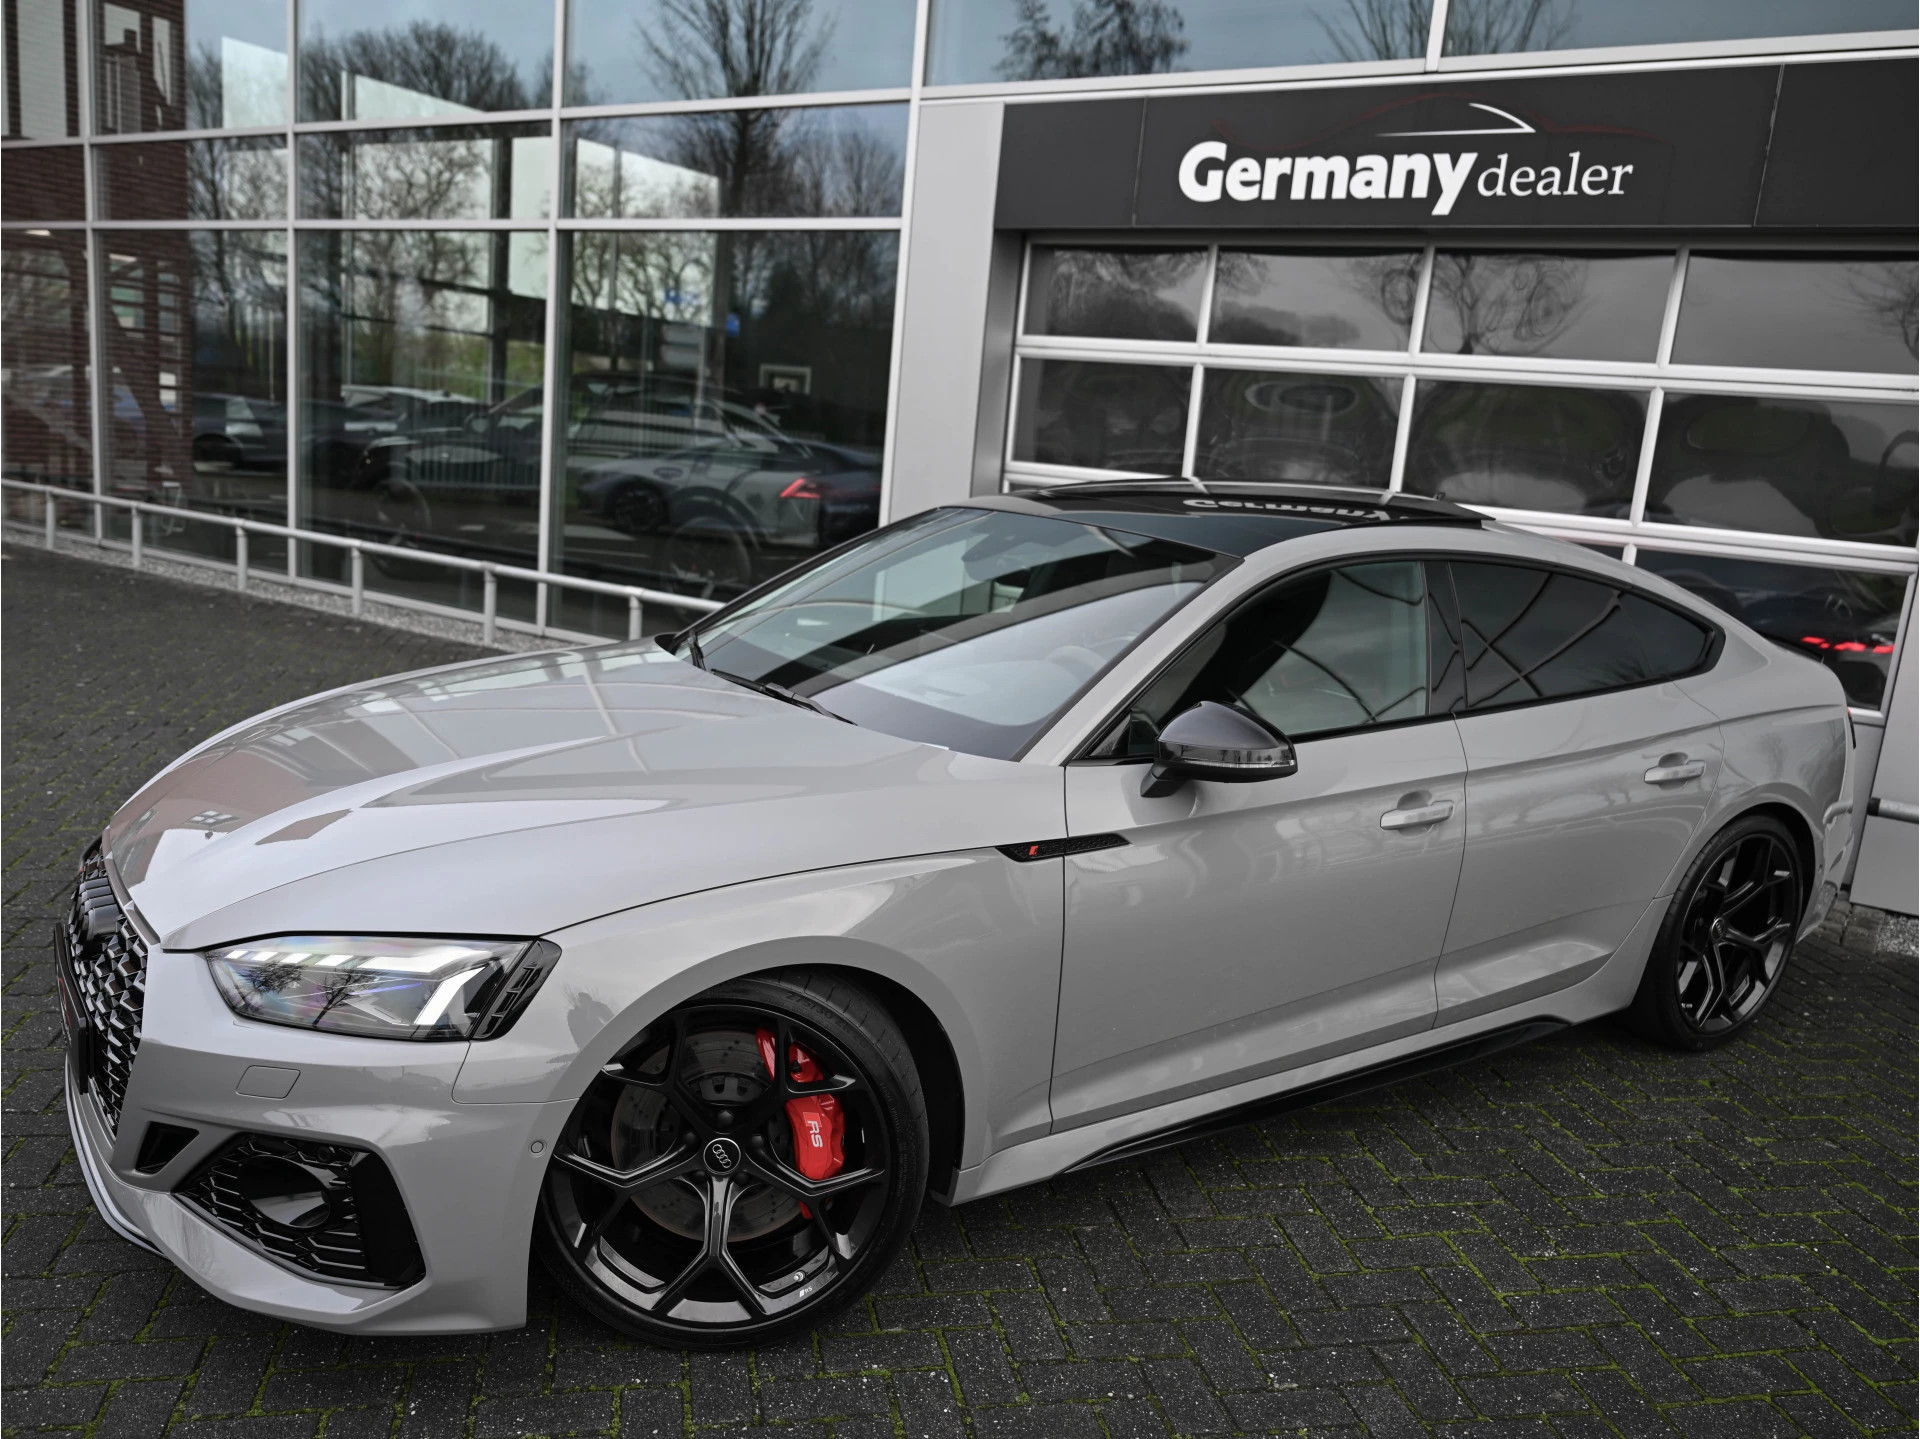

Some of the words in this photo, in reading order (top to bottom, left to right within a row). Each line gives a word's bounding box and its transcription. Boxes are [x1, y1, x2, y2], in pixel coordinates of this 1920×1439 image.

[1178, 141, 1479, 216] Germany
[1477, 151, 1634, 197] dealer
[807, 1120, 823, 1148] RS
